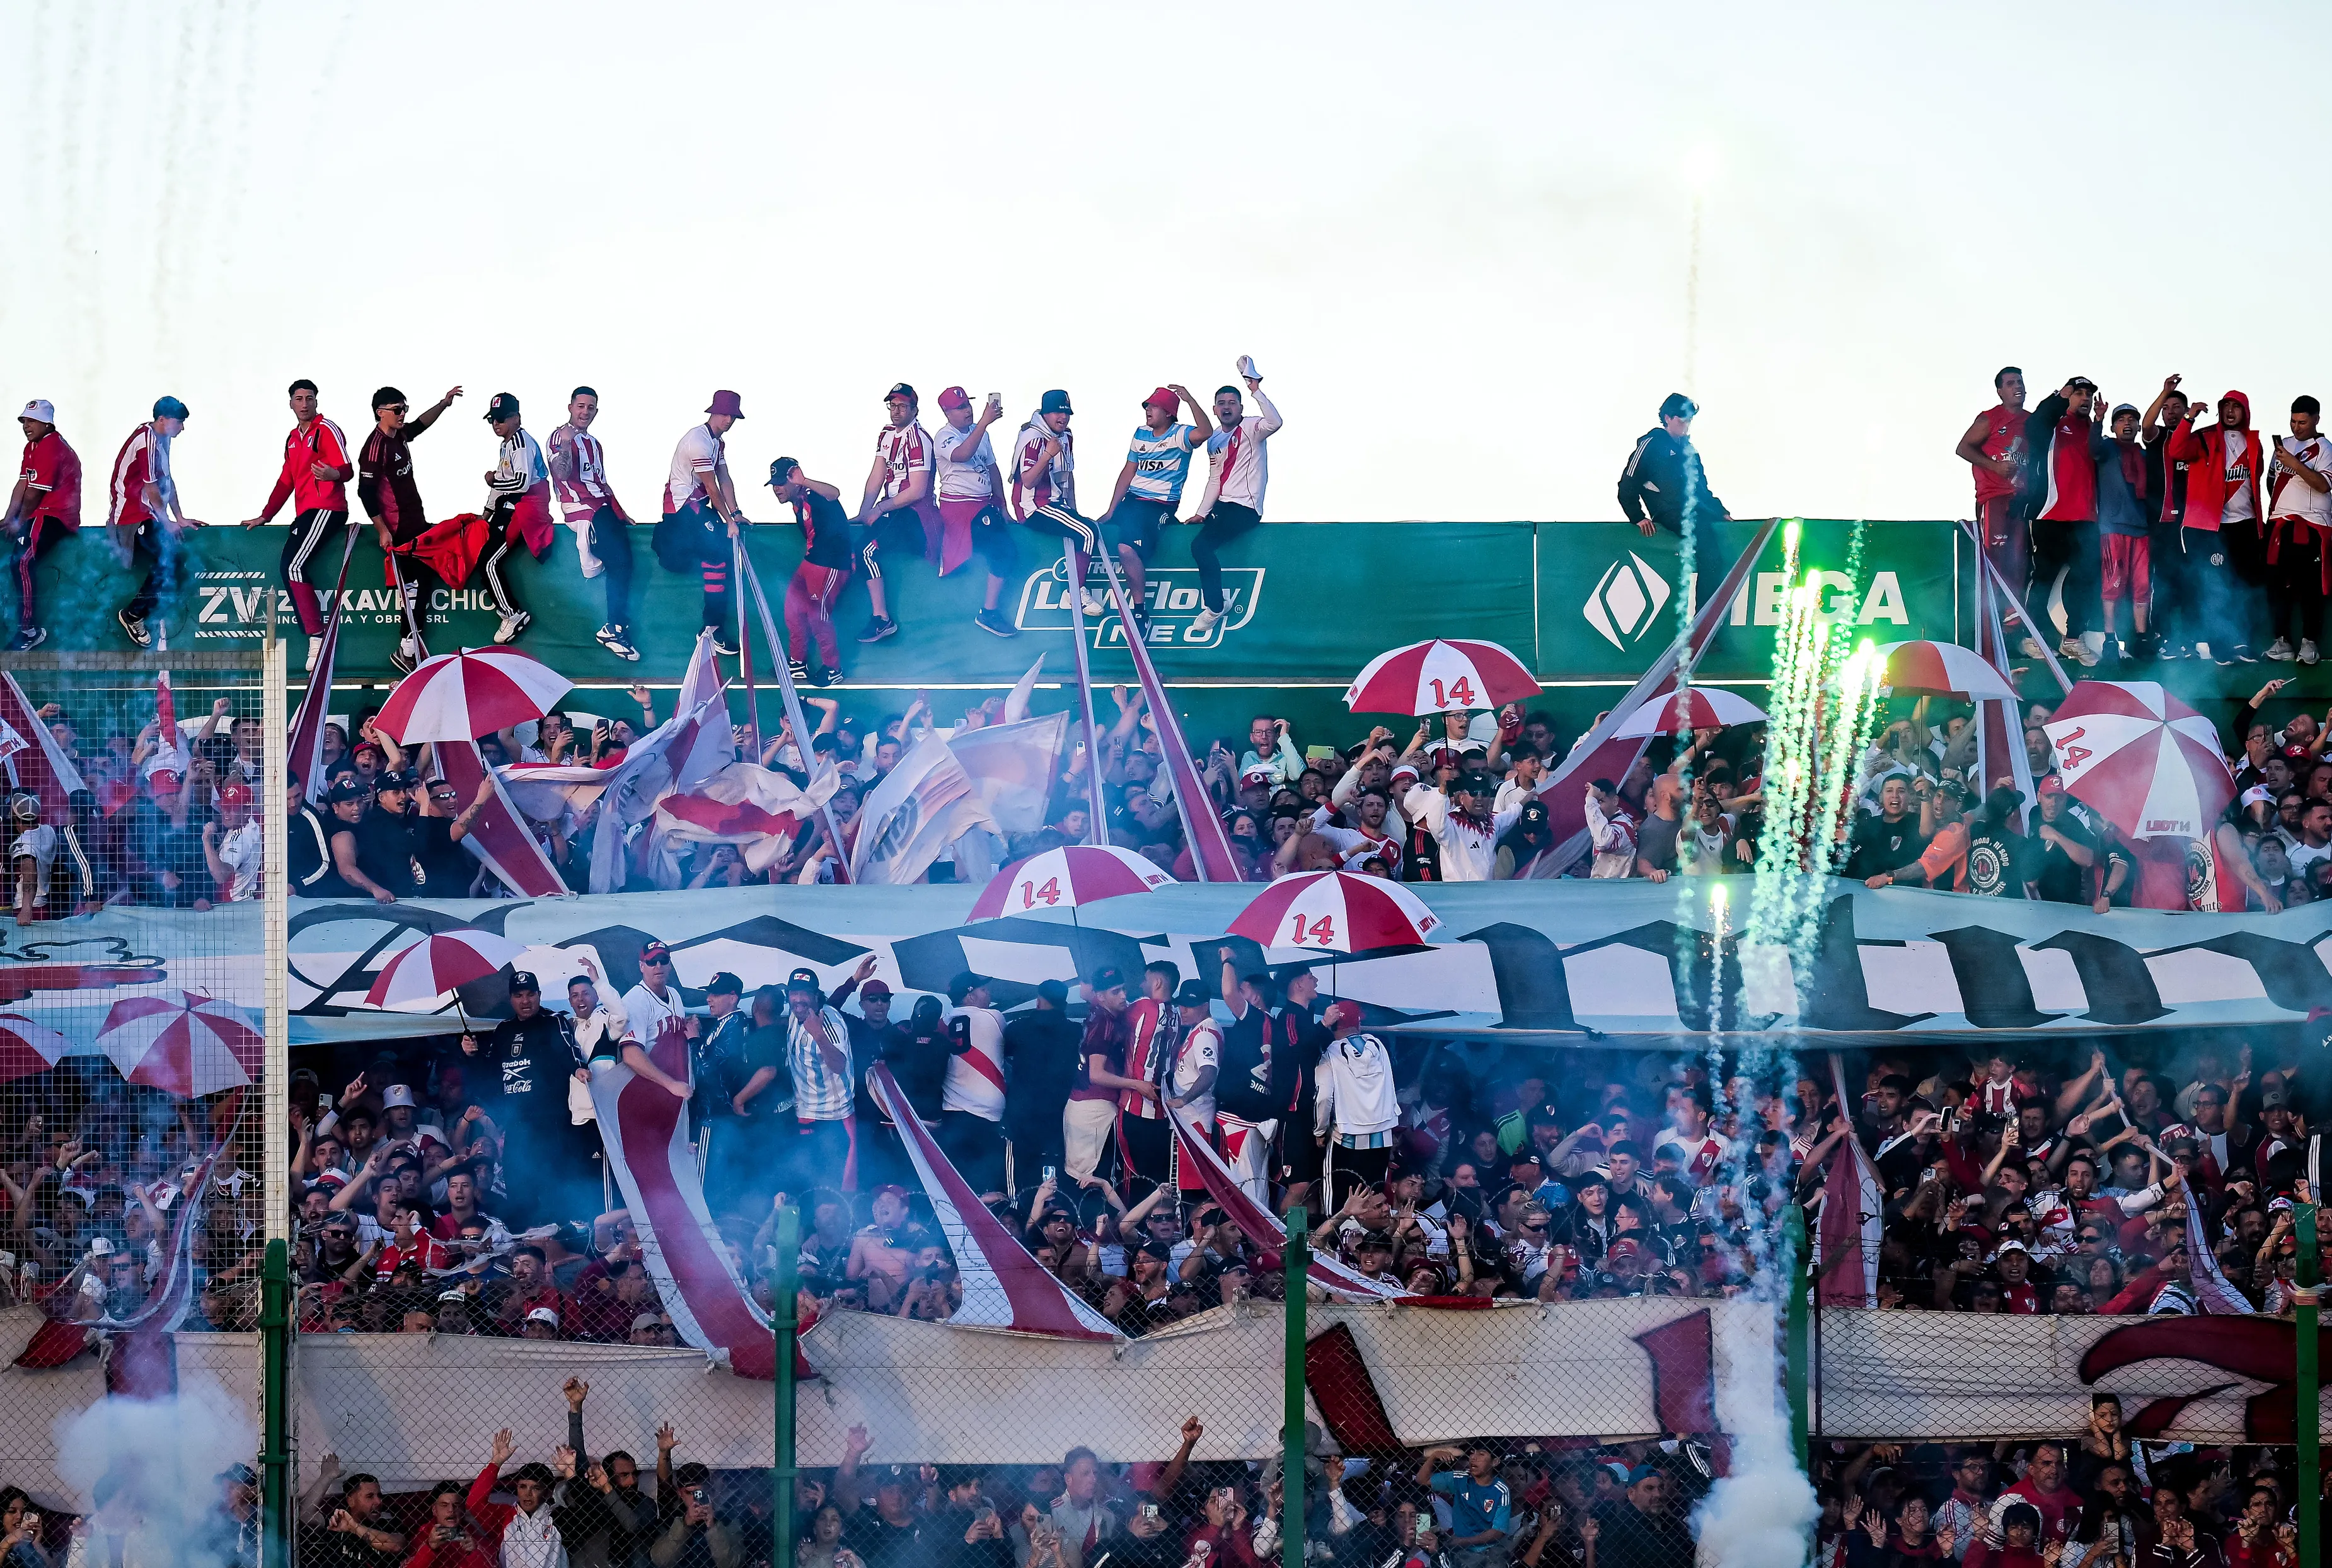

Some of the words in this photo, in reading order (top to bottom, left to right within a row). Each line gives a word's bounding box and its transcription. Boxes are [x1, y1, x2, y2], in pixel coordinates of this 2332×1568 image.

[1139, 461, 1164, 471] VISA
[2176, 462, 2190, 470] Be
[2225, 464, 2250, 482] uilm
[199, 587, 263, 623] ZV
[361, 615, 368, 623] Y
[375, 615, 402, 623] OBR
[426, 614, 449, 623] SRL
[1429, 676, 1475, 709] 14
[2055, 727, 2093, 771] 14
[1020, 877, 1061, 909] 14
[1291, 913, 1335, 946] 14
